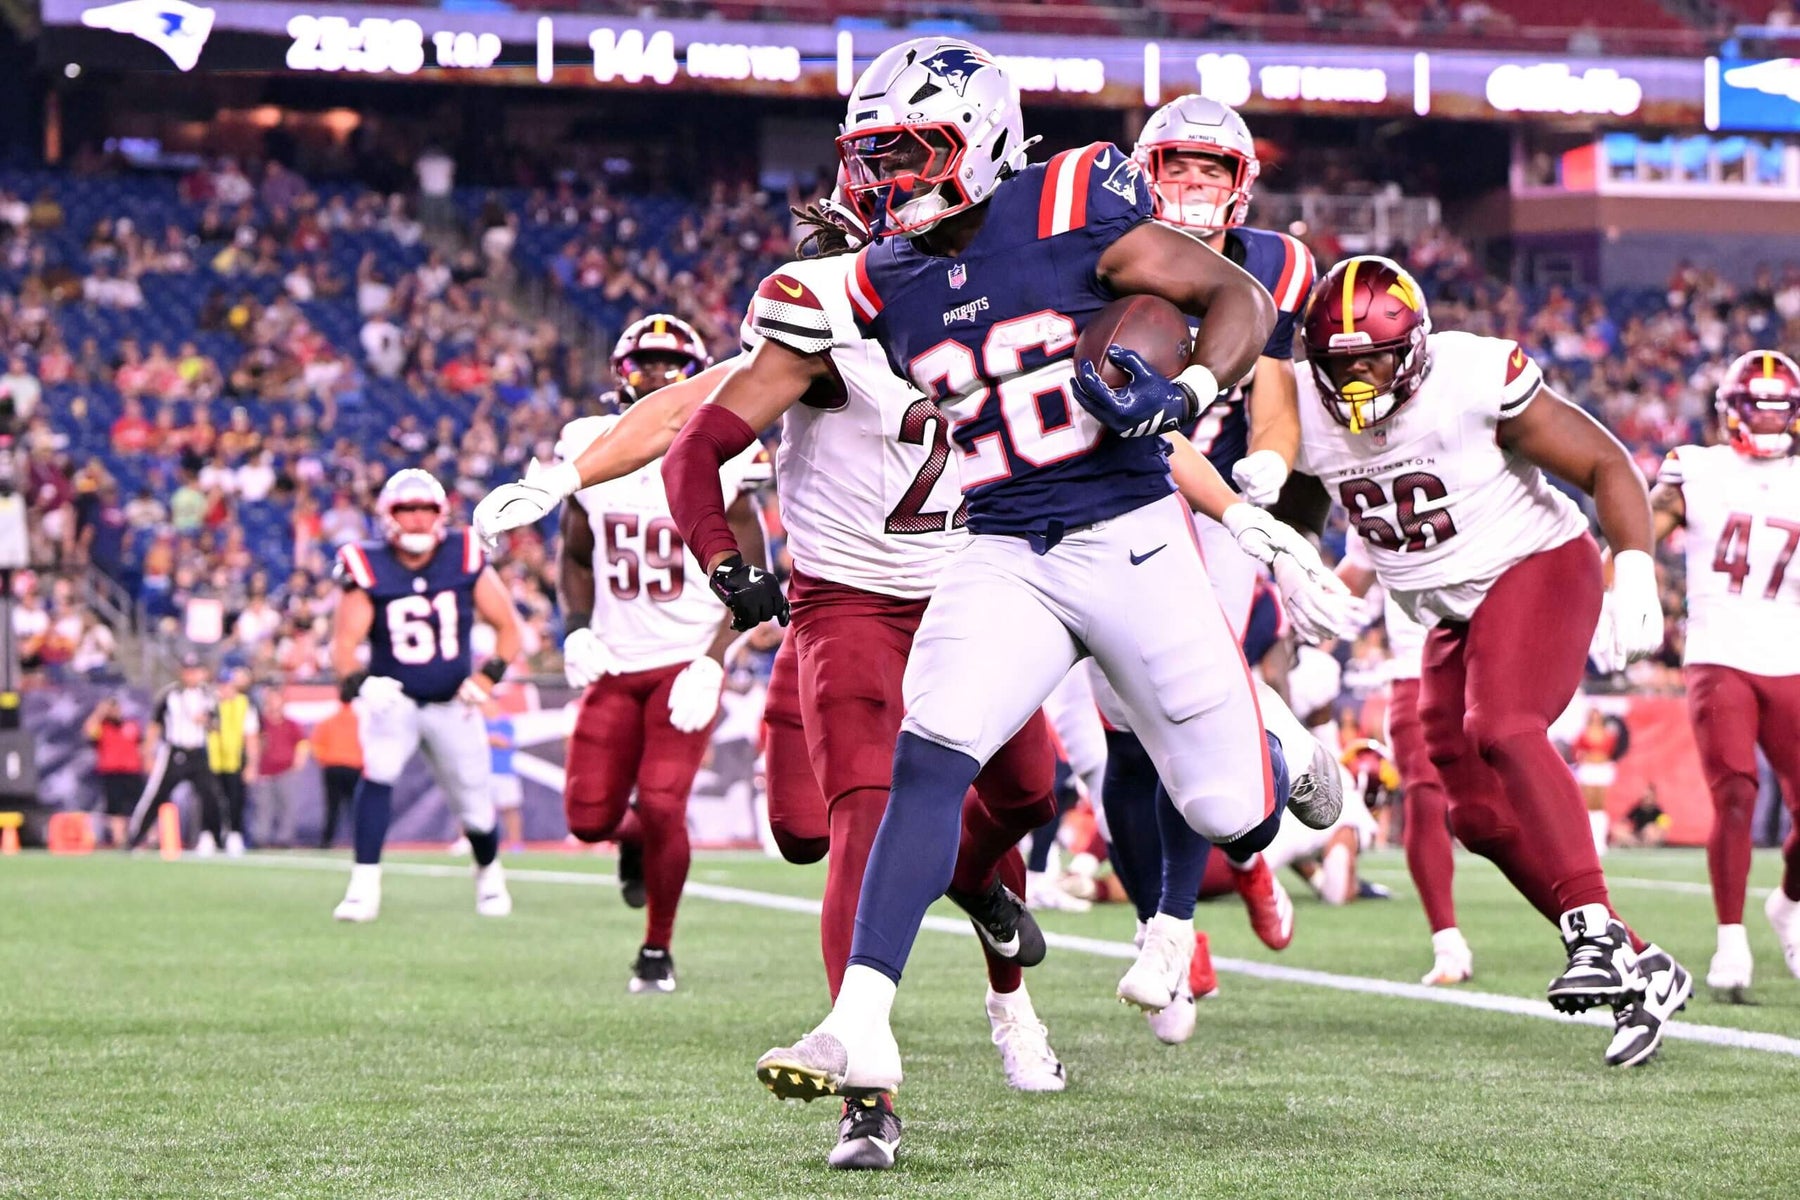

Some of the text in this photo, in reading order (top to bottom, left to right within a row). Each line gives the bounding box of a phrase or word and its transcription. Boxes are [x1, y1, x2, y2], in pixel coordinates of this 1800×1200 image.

[589, 28, 678, 84] 144
[942, 296, 990, 326] PATRIOTS
[909, 308, 1105, 490] 26
[884, 396, 970, 535] 2
[1338, 457, 1435, 477] WASHINGTON
[1338, 471, 1458, 553] 66
[603, 513, 685, 603] 59
[1712, 511, 1800, 600] 47
[386, 590, 459, 664] 61
